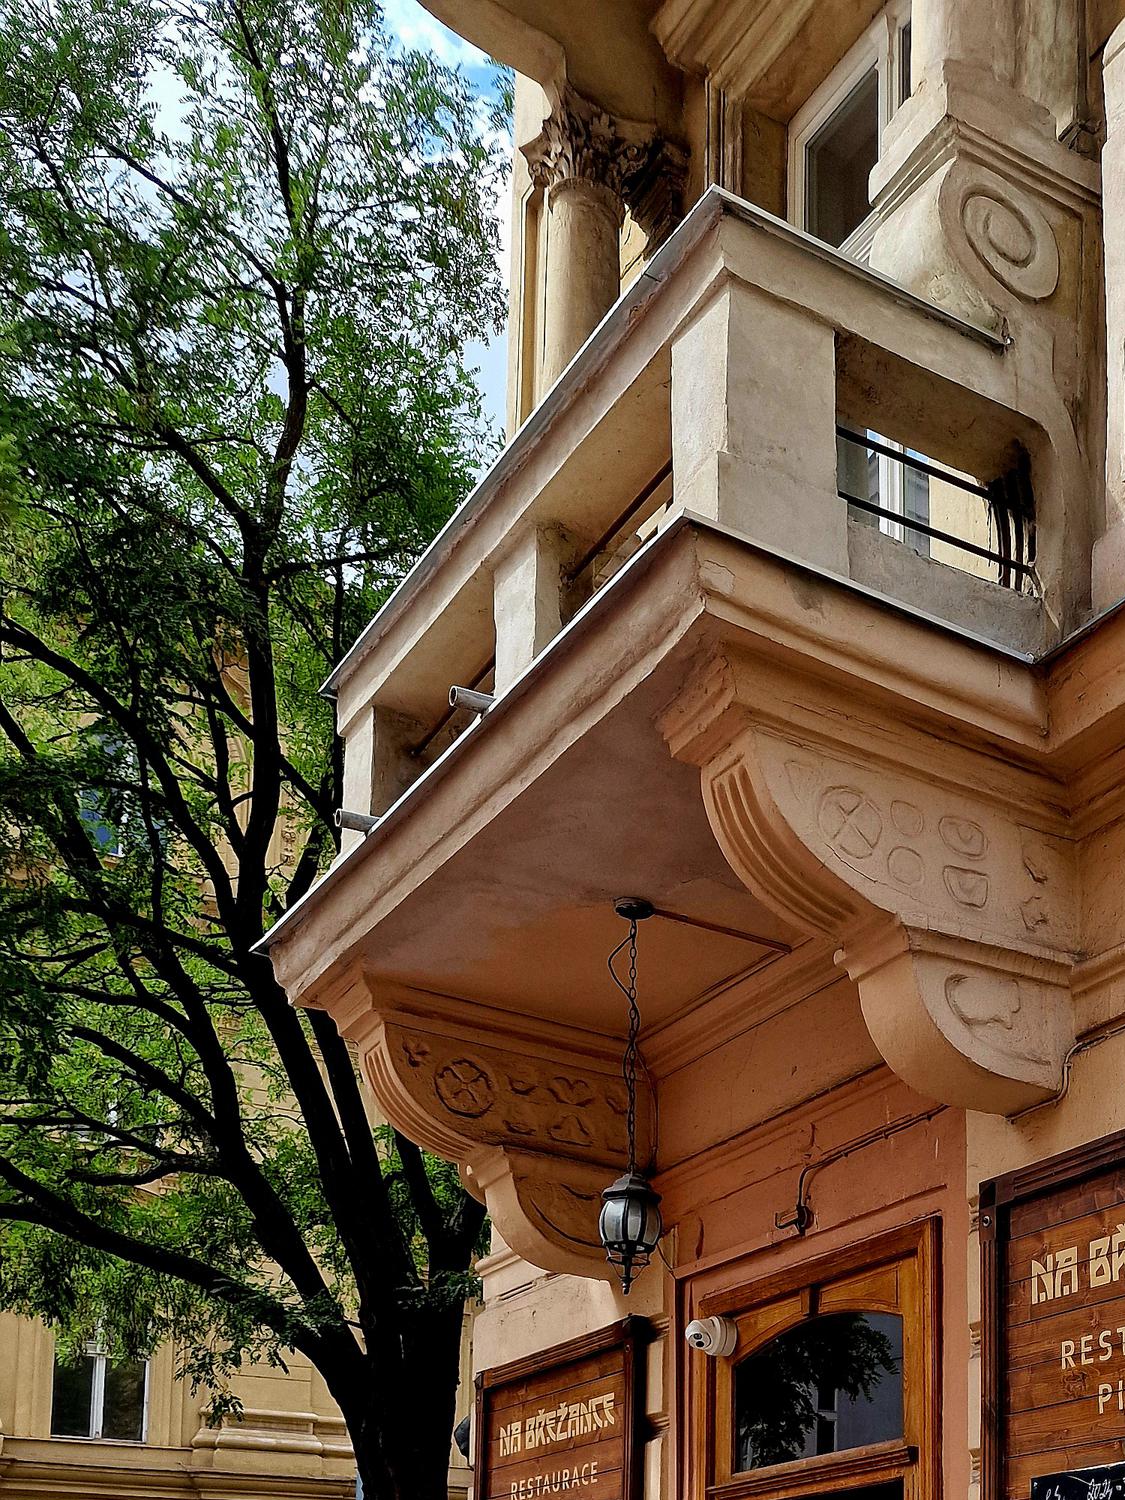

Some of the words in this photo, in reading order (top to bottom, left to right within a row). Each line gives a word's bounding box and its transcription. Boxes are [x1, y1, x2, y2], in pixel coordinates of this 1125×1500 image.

[1031, 1245, 1079, 1306] NA
[499, 1419, 521, 1458] NA
[525, 1392, 615, 1450] BŘEŽANCE
